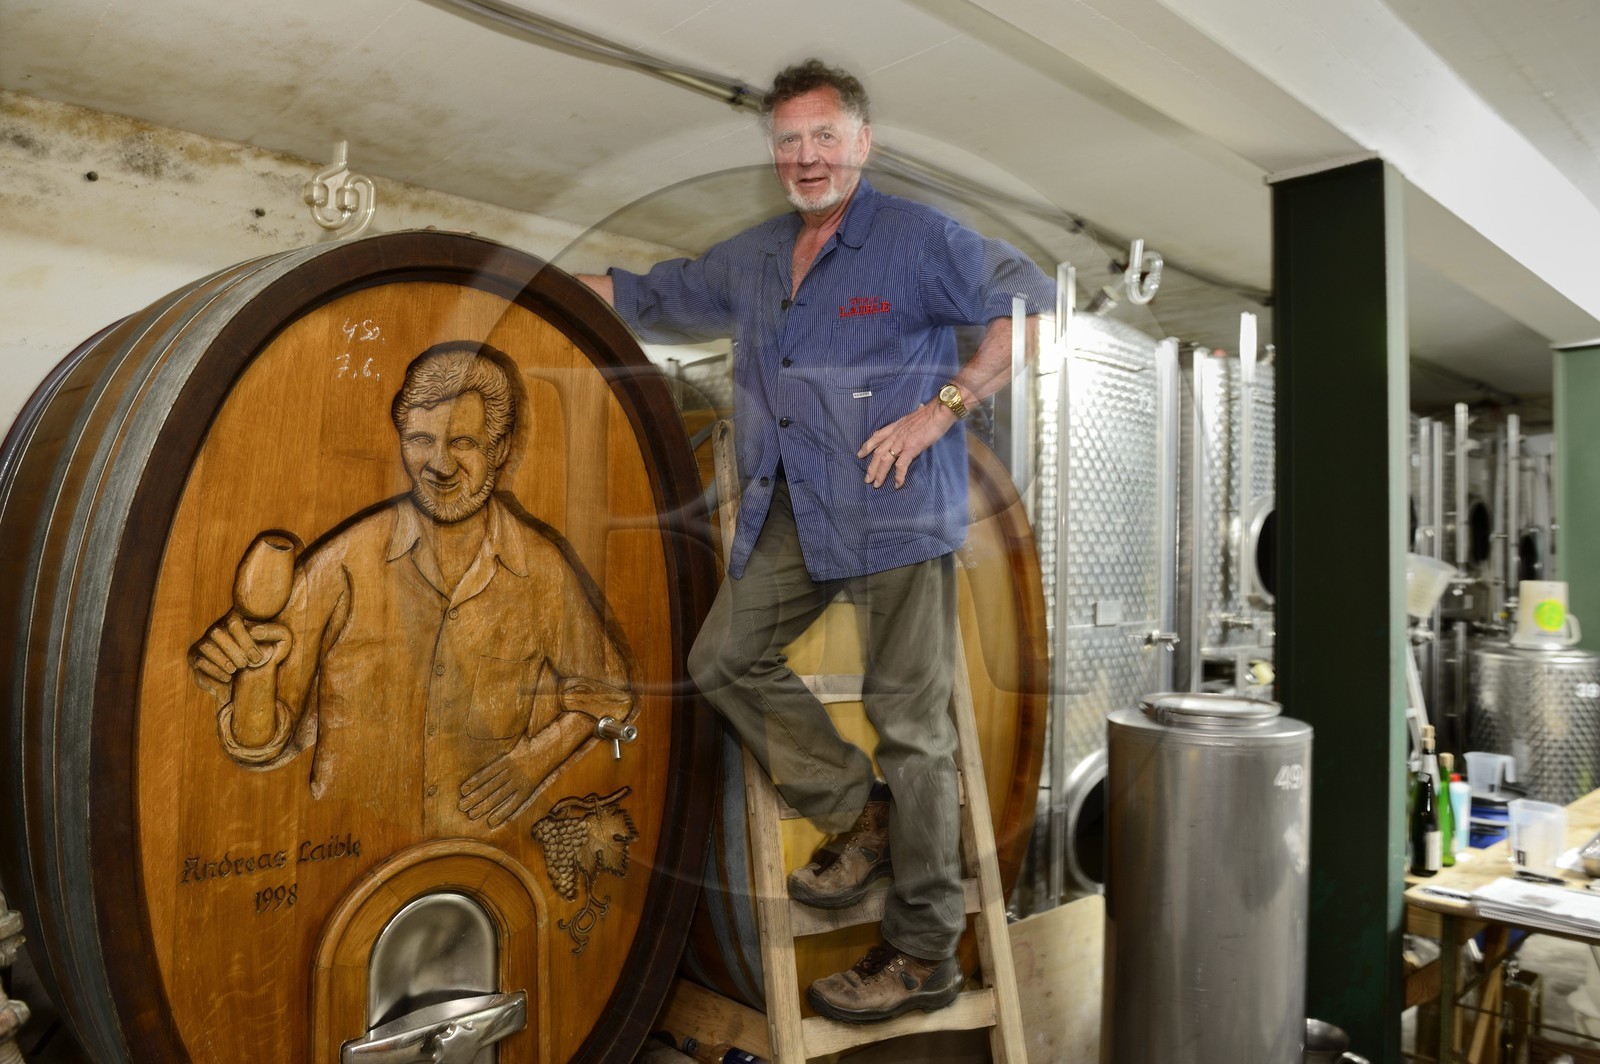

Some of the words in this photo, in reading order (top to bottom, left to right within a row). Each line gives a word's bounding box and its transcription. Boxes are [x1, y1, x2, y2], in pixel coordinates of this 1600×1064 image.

[1273, 763, 1304, 790] 49
[180, 850, 288, 884] Andreas
[297, 833, 361, 864] Laible
[255, 883, 299, 913] 1998
